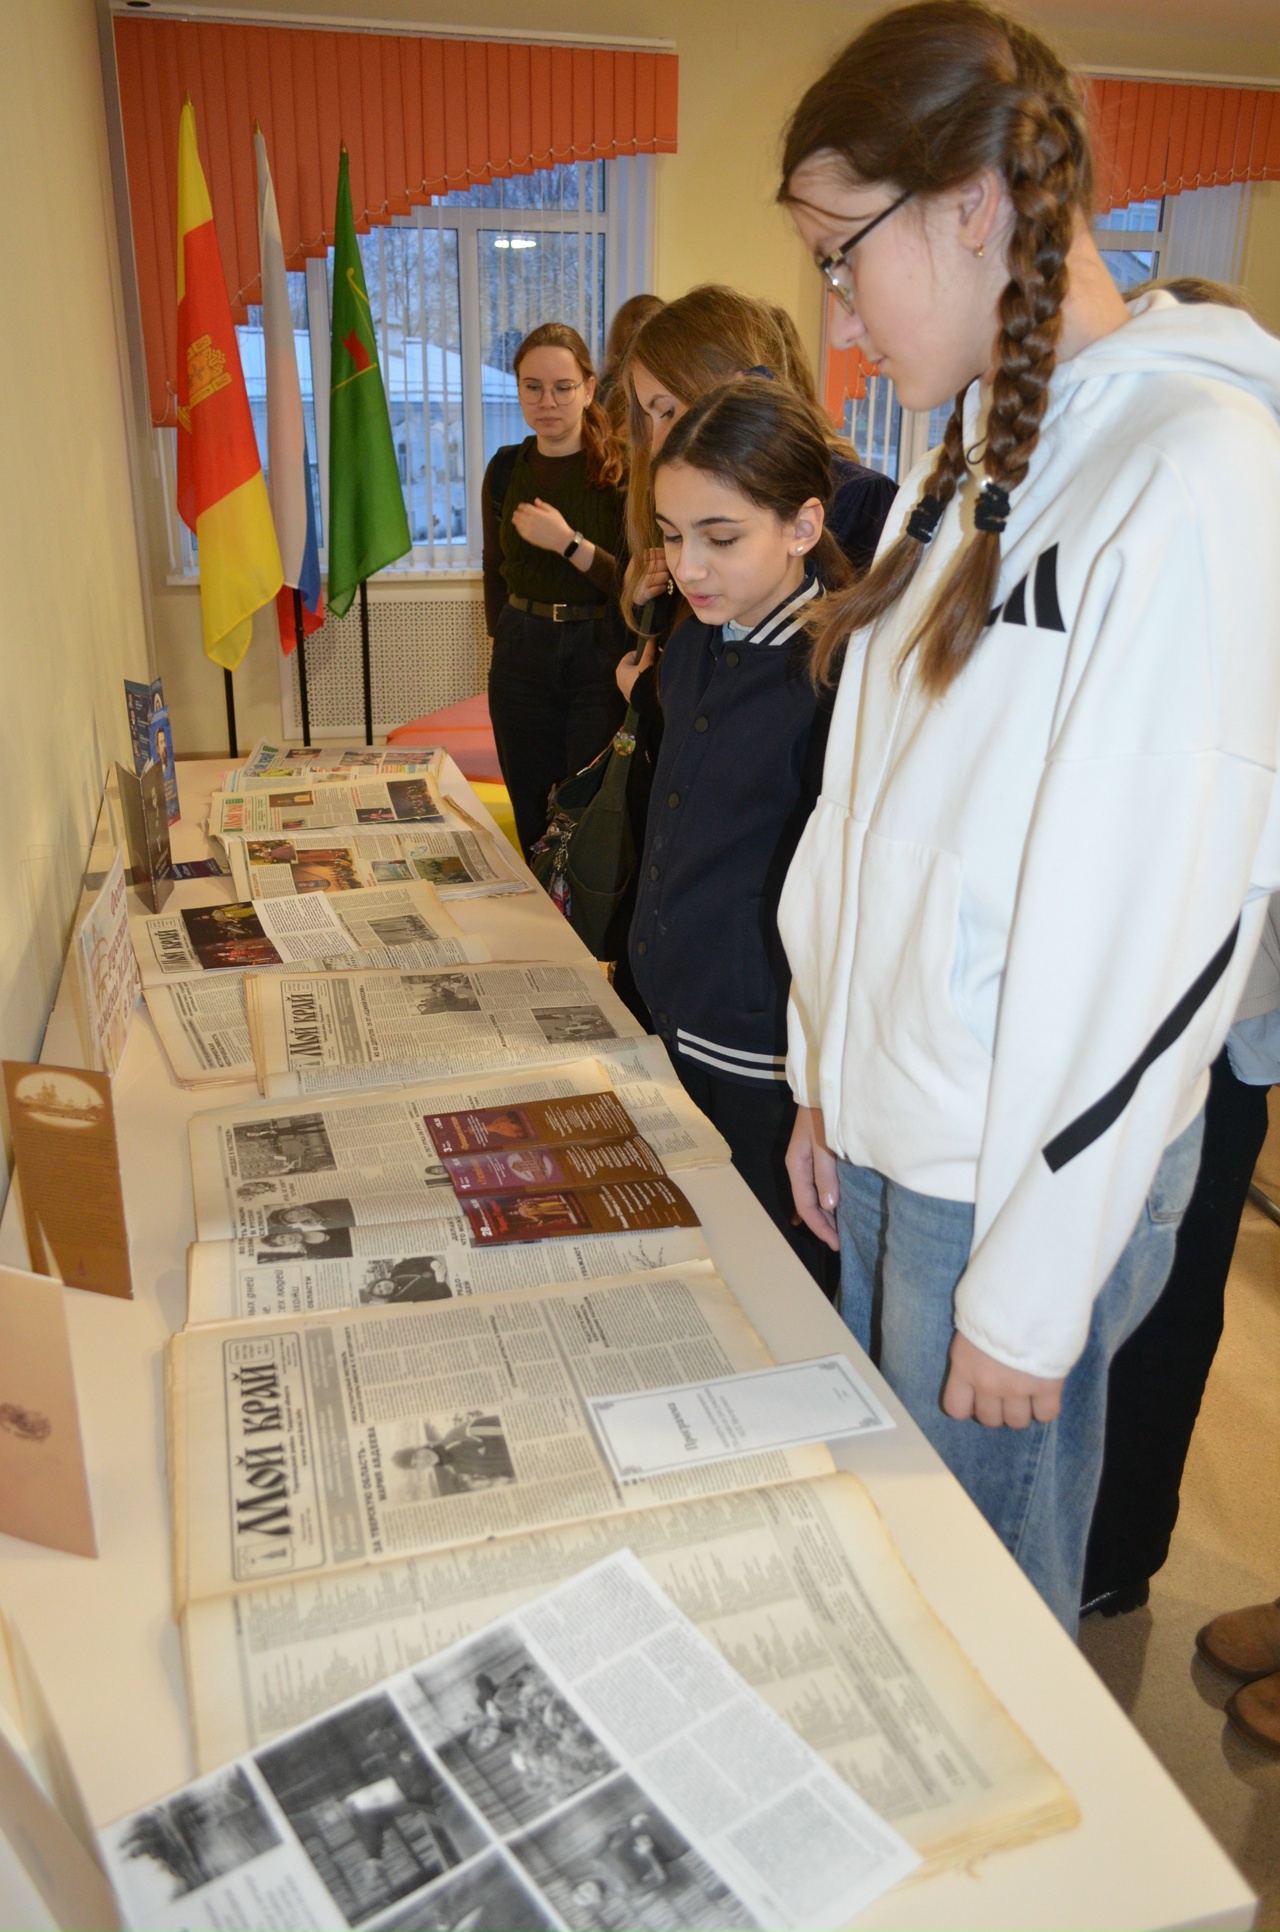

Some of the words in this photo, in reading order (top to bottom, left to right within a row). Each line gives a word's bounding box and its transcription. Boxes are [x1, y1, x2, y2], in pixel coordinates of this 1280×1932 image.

[154, 929, 183, 950] край
[286, 992, 319, 1024] край
[288, 1025, 323, 1056] Мой
[480, 1226, 493, 1237] 28
[574, 1247, 588, 1277] УВАЖАЮТ
[245, 1277, 256, 1299] дней
[275, 1269, 284, 1297] людей
[305, 1276, 314, 1309] ОБЛАСТИ
[230, 1360, 282, 1435] край
[665, 1402, 699, 1452] Программа
[367, 1426, 383, 1469] АВДЕЕВА
[358, 1447, 373, 1489] ОБЛАСТЬ
[233, 1443, 292, 1538] Мой
[373, 1471, 388, 1501] МАРИЯ
[363, 1491, 382, 1538] ТВЕРСКУЮ
[372, 1539, 383, 1553] ЗА
